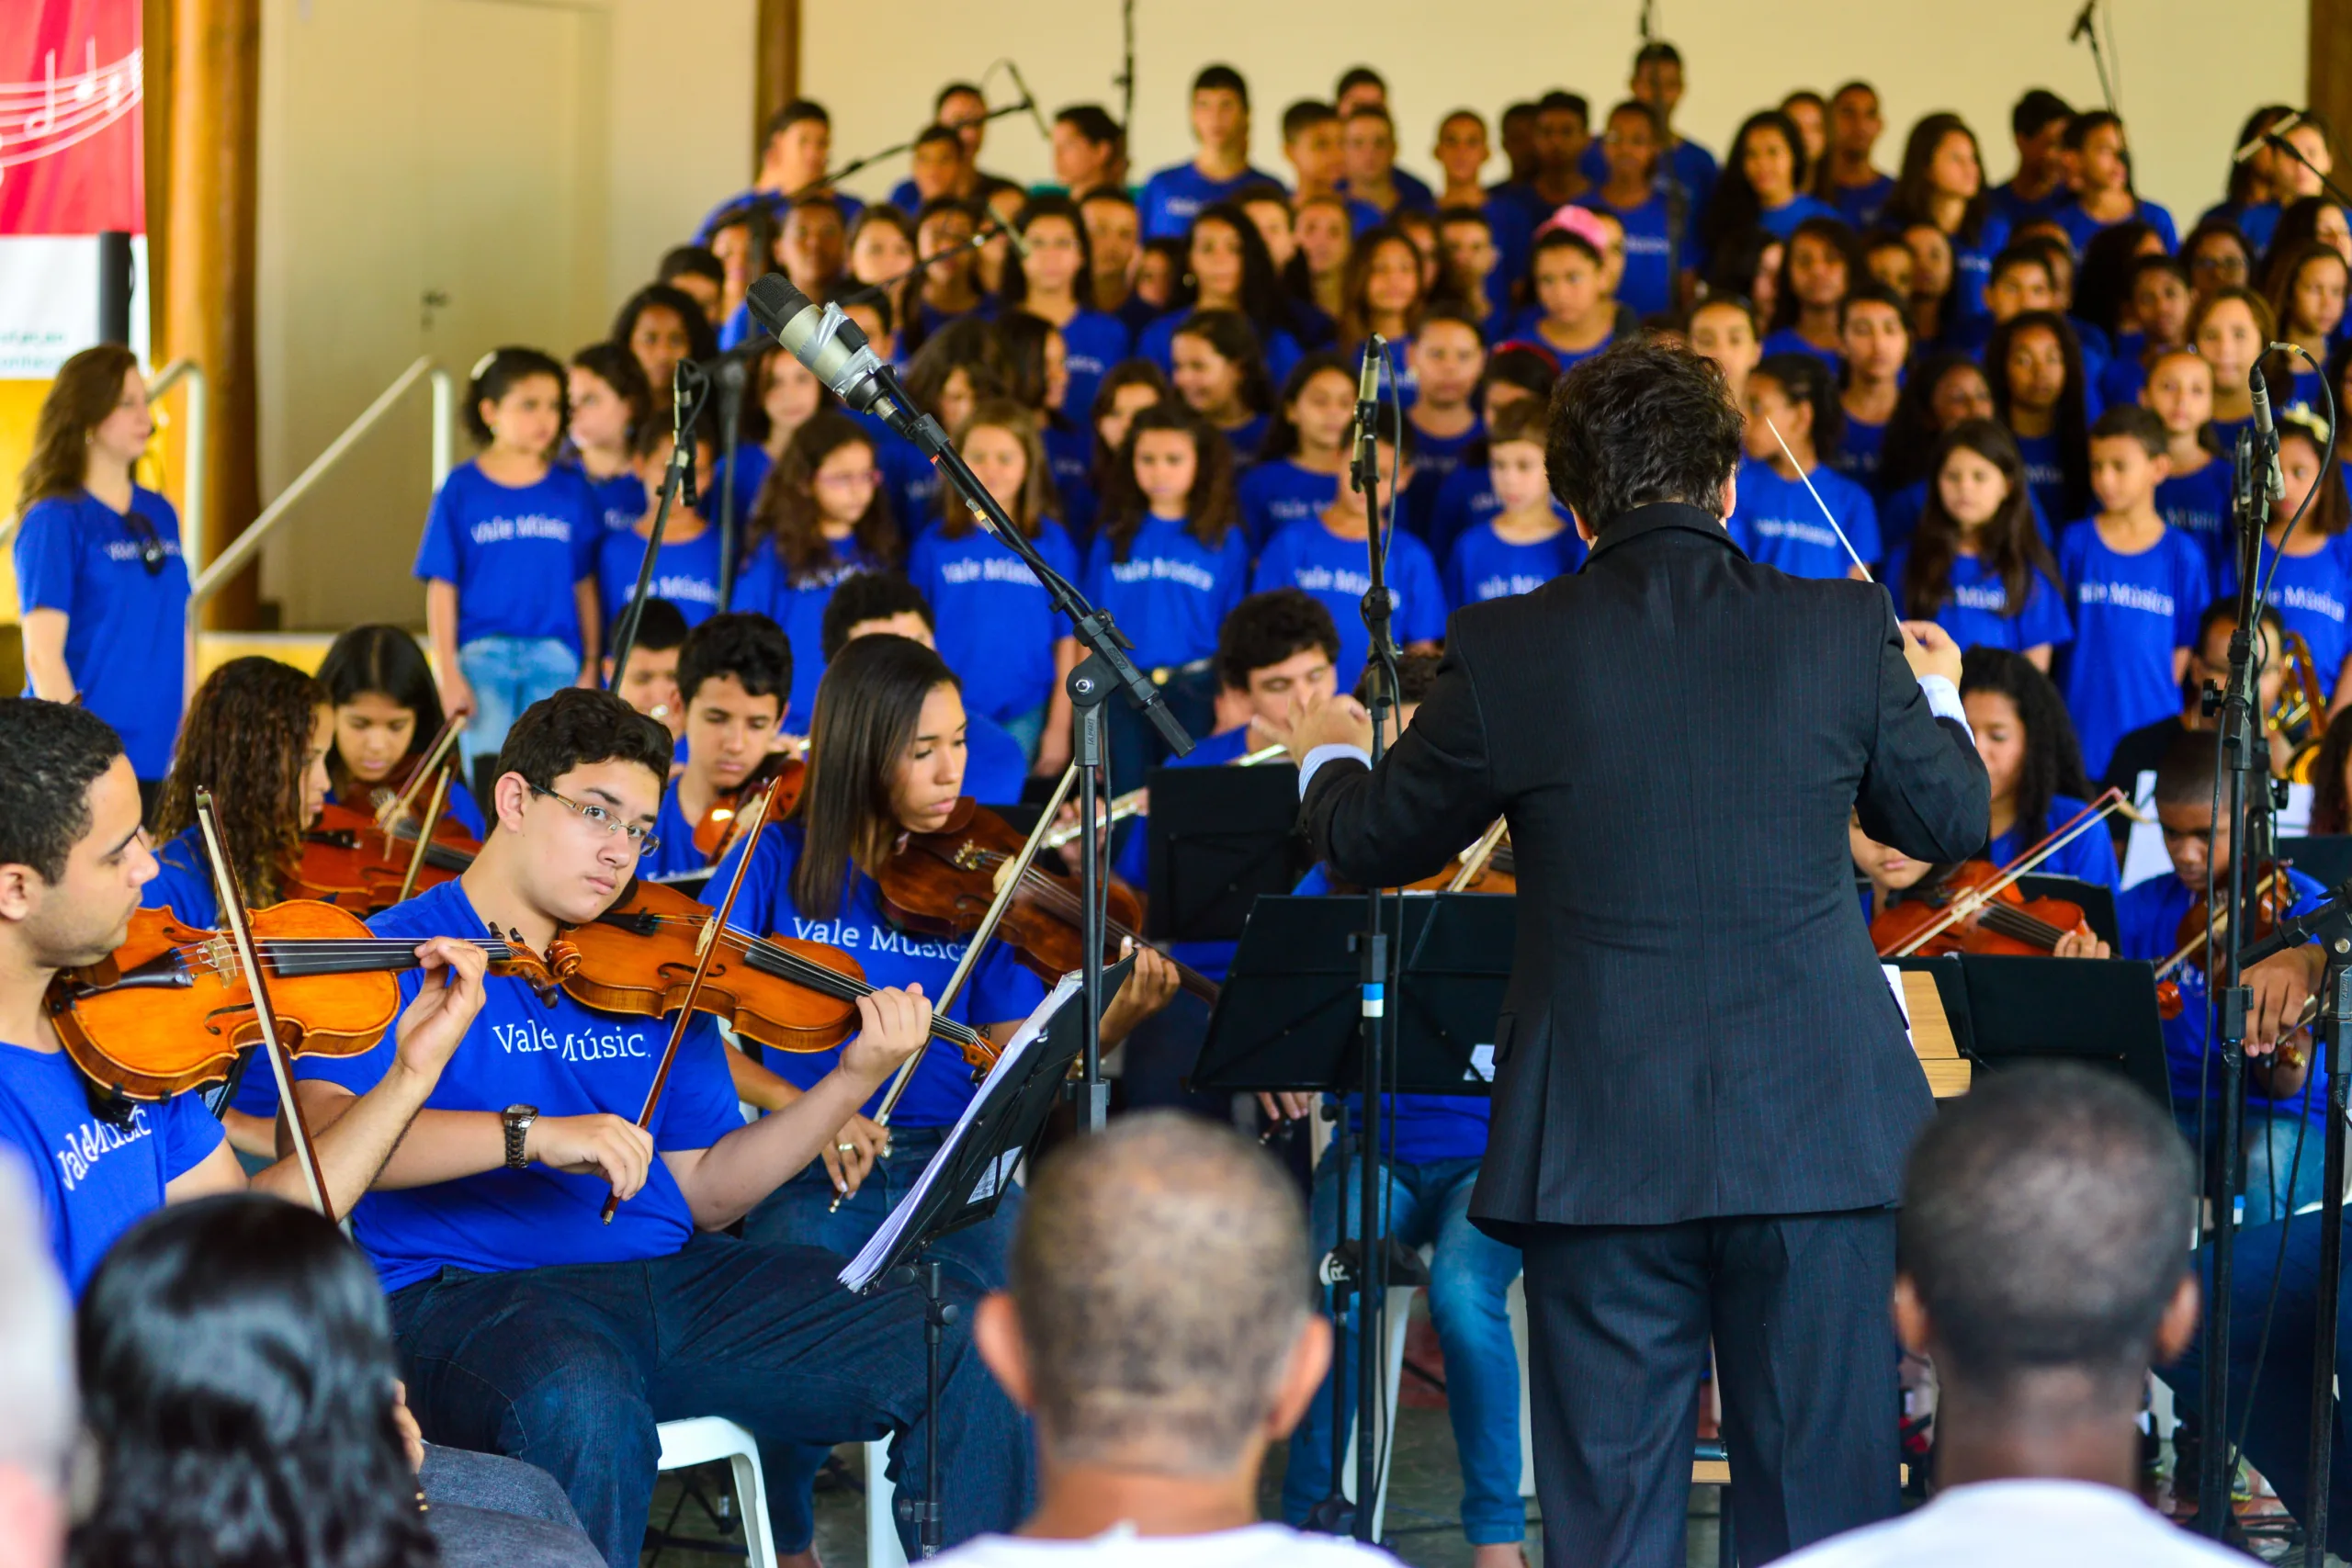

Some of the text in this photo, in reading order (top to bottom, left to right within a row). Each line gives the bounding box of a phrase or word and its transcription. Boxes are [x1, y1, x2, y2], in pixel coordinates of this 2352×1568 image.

[793, 917, 860, 947] Vale
[492, 1019, 650, 1061] Vale Músic
